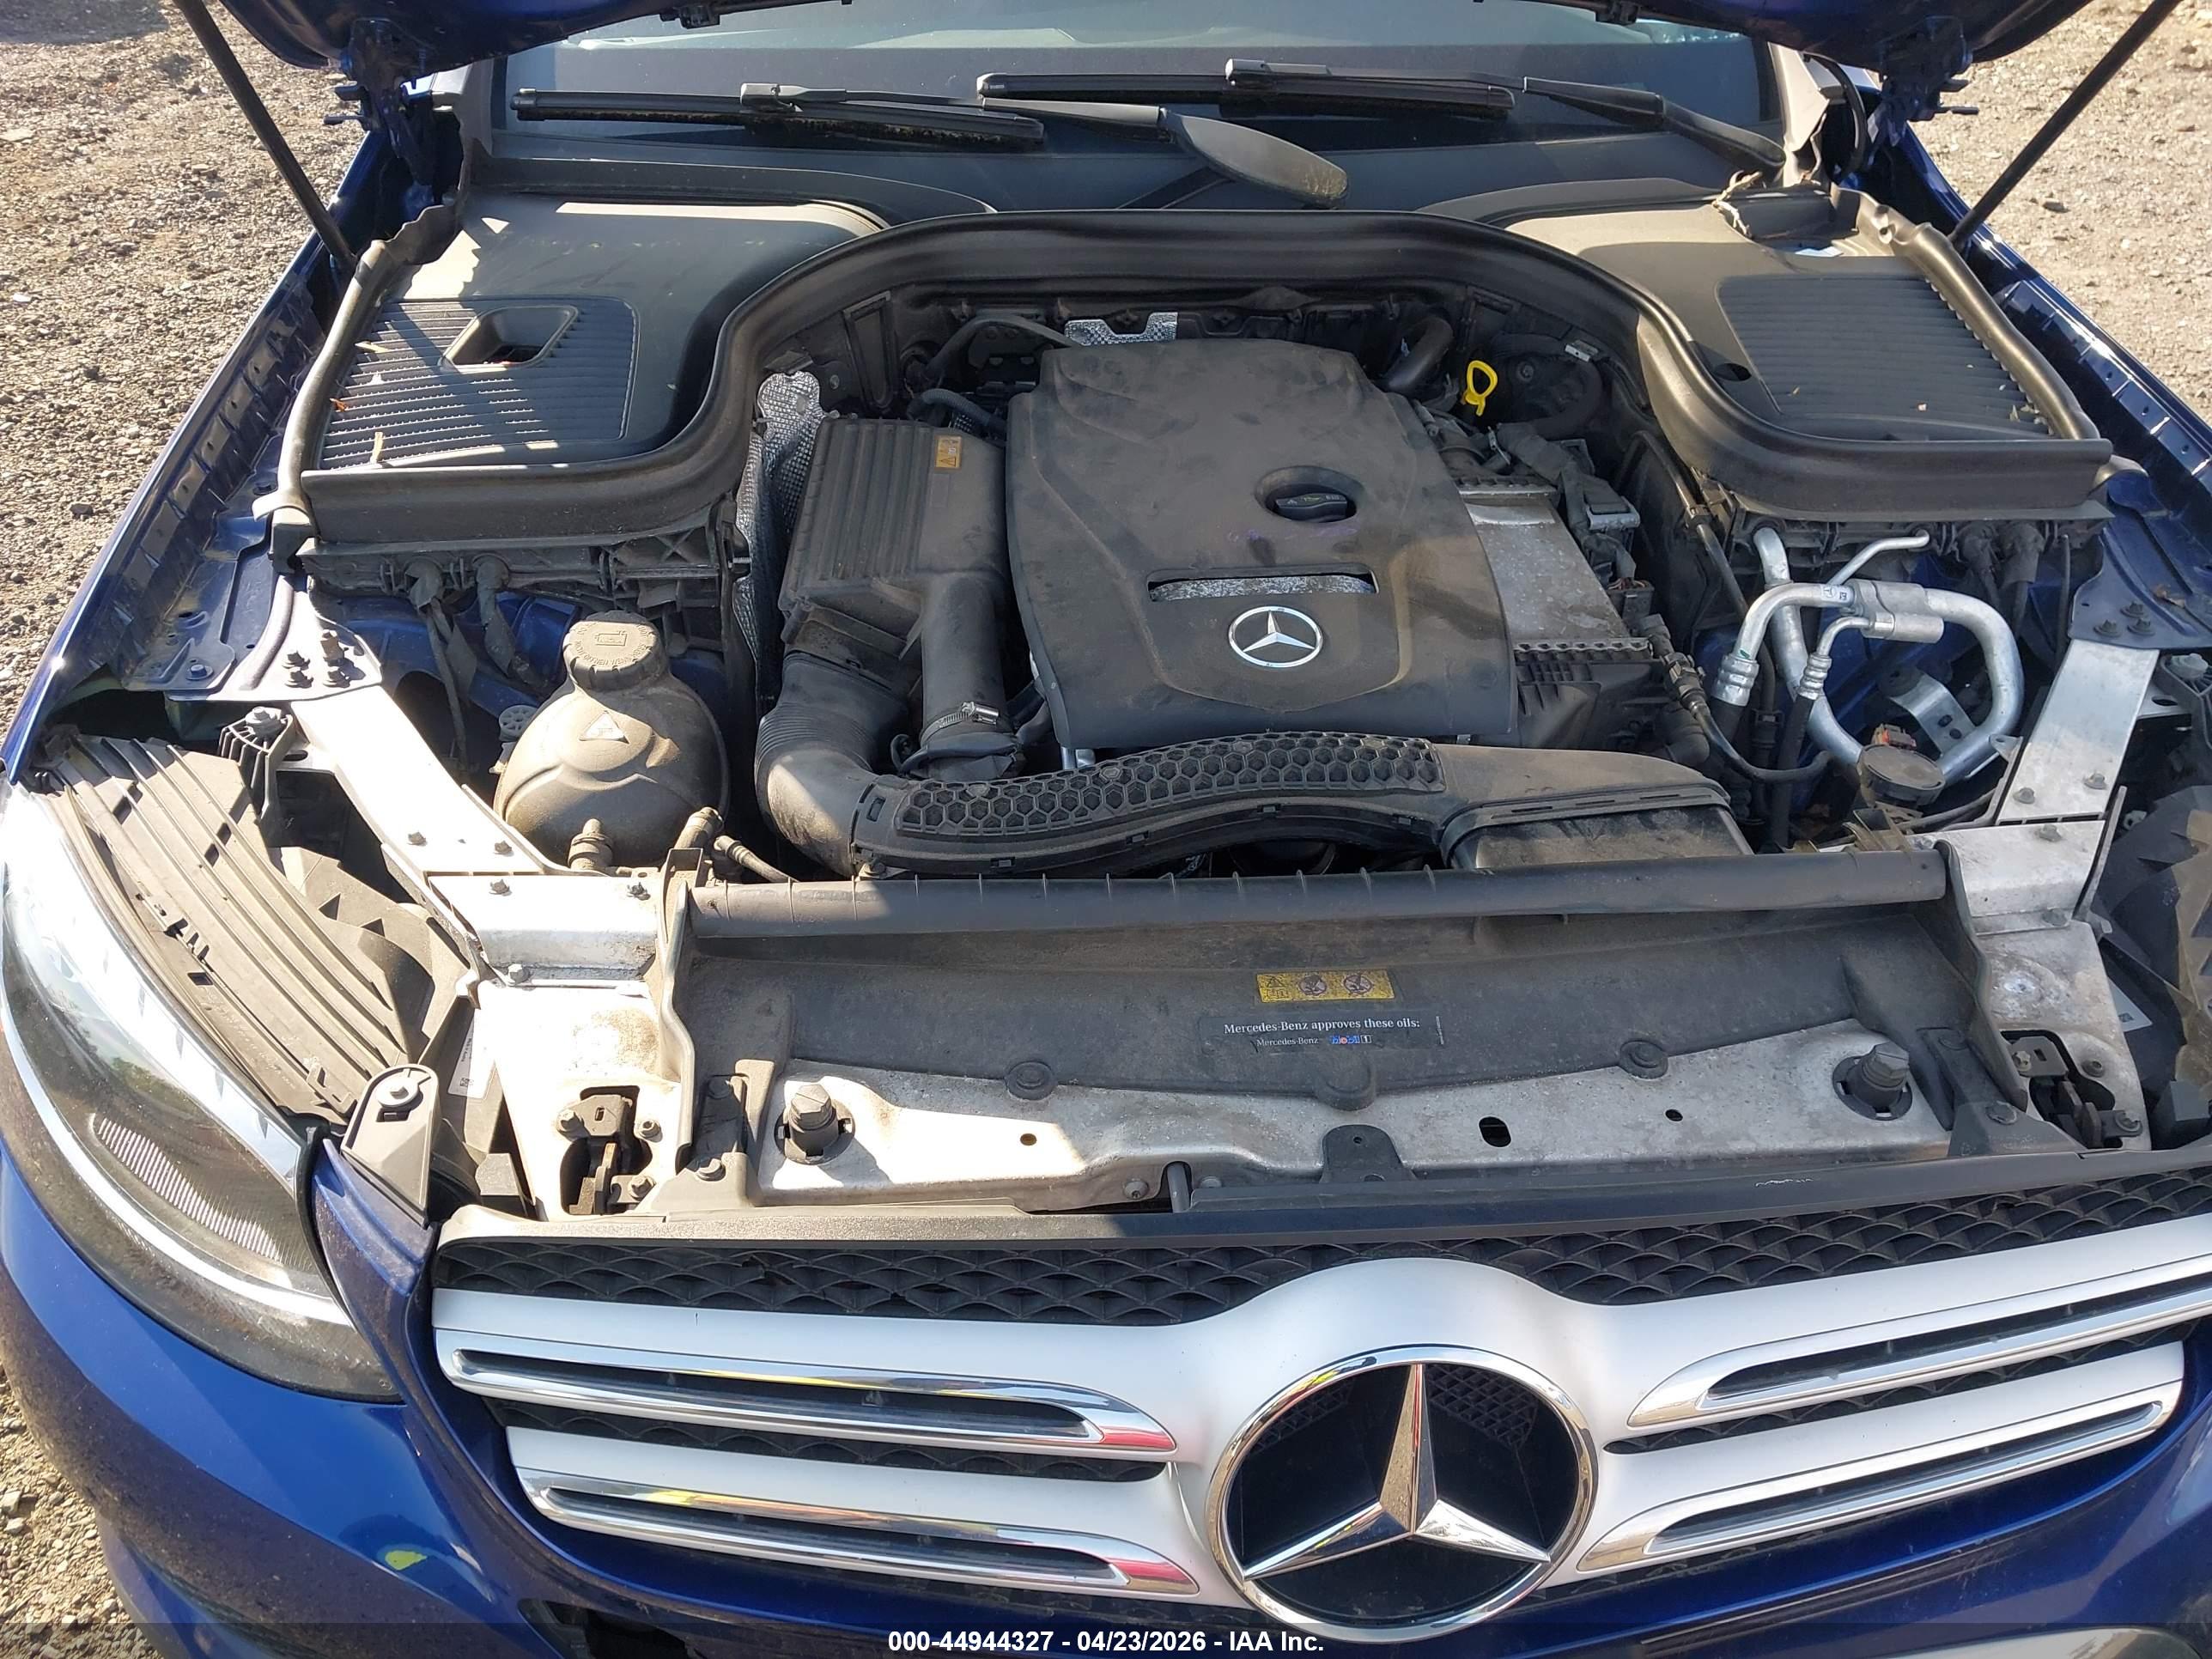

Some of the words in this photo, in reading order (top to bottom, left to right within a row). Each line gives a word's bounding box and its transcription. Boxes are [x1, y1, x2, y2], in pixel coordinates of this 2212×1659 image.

[1224, 1022, 1309, 1034] Mercedes-Benz
[1311, 1020, 1361, 1032] approves
[1364, 1018, 1395, 1029] these
[1396, 1018, 1420, 1029] oils:
[1256, 1037, 1319, 1047] Mercedes-Benz
